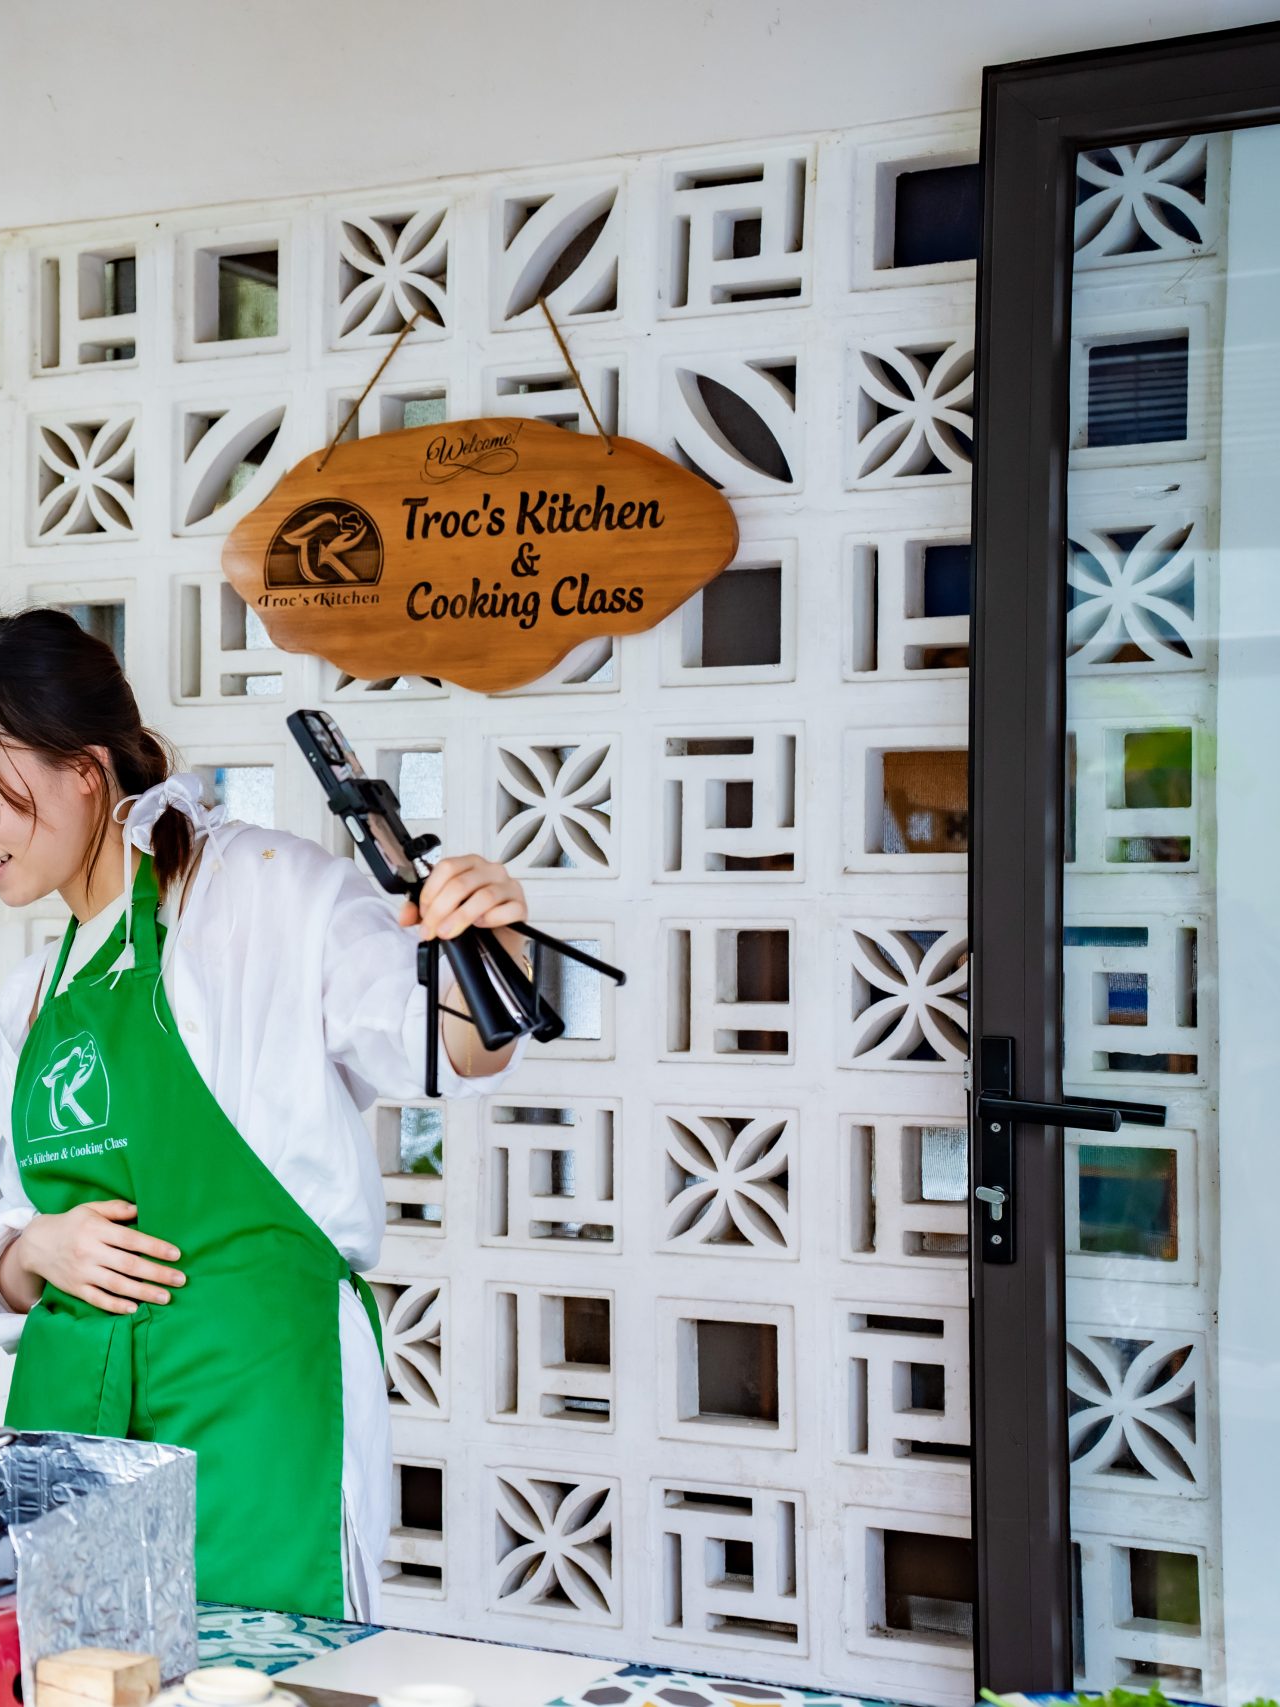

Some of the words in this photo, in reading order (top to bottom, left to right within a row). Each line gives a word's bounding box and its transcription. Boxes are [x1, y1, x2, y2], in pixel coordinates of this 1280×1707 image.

[402, 493, 506, 540] Troc's
[516, 485, 665, 535] Kitchen
[511, 542, 541, 577] &
[257, 594, 309, 608] Troc's
[313, 590, 380, 608] Kitchen
[406, 577, 541, 630] Cooking
[551, 573, 644, 616] Class
[33, 1151, 60, 1165] Kitchen
[60, 1147, 69, 1160] &
[70, 1142, 103, 1158] Cooking
[104, 1137, 128, 1151] Class
